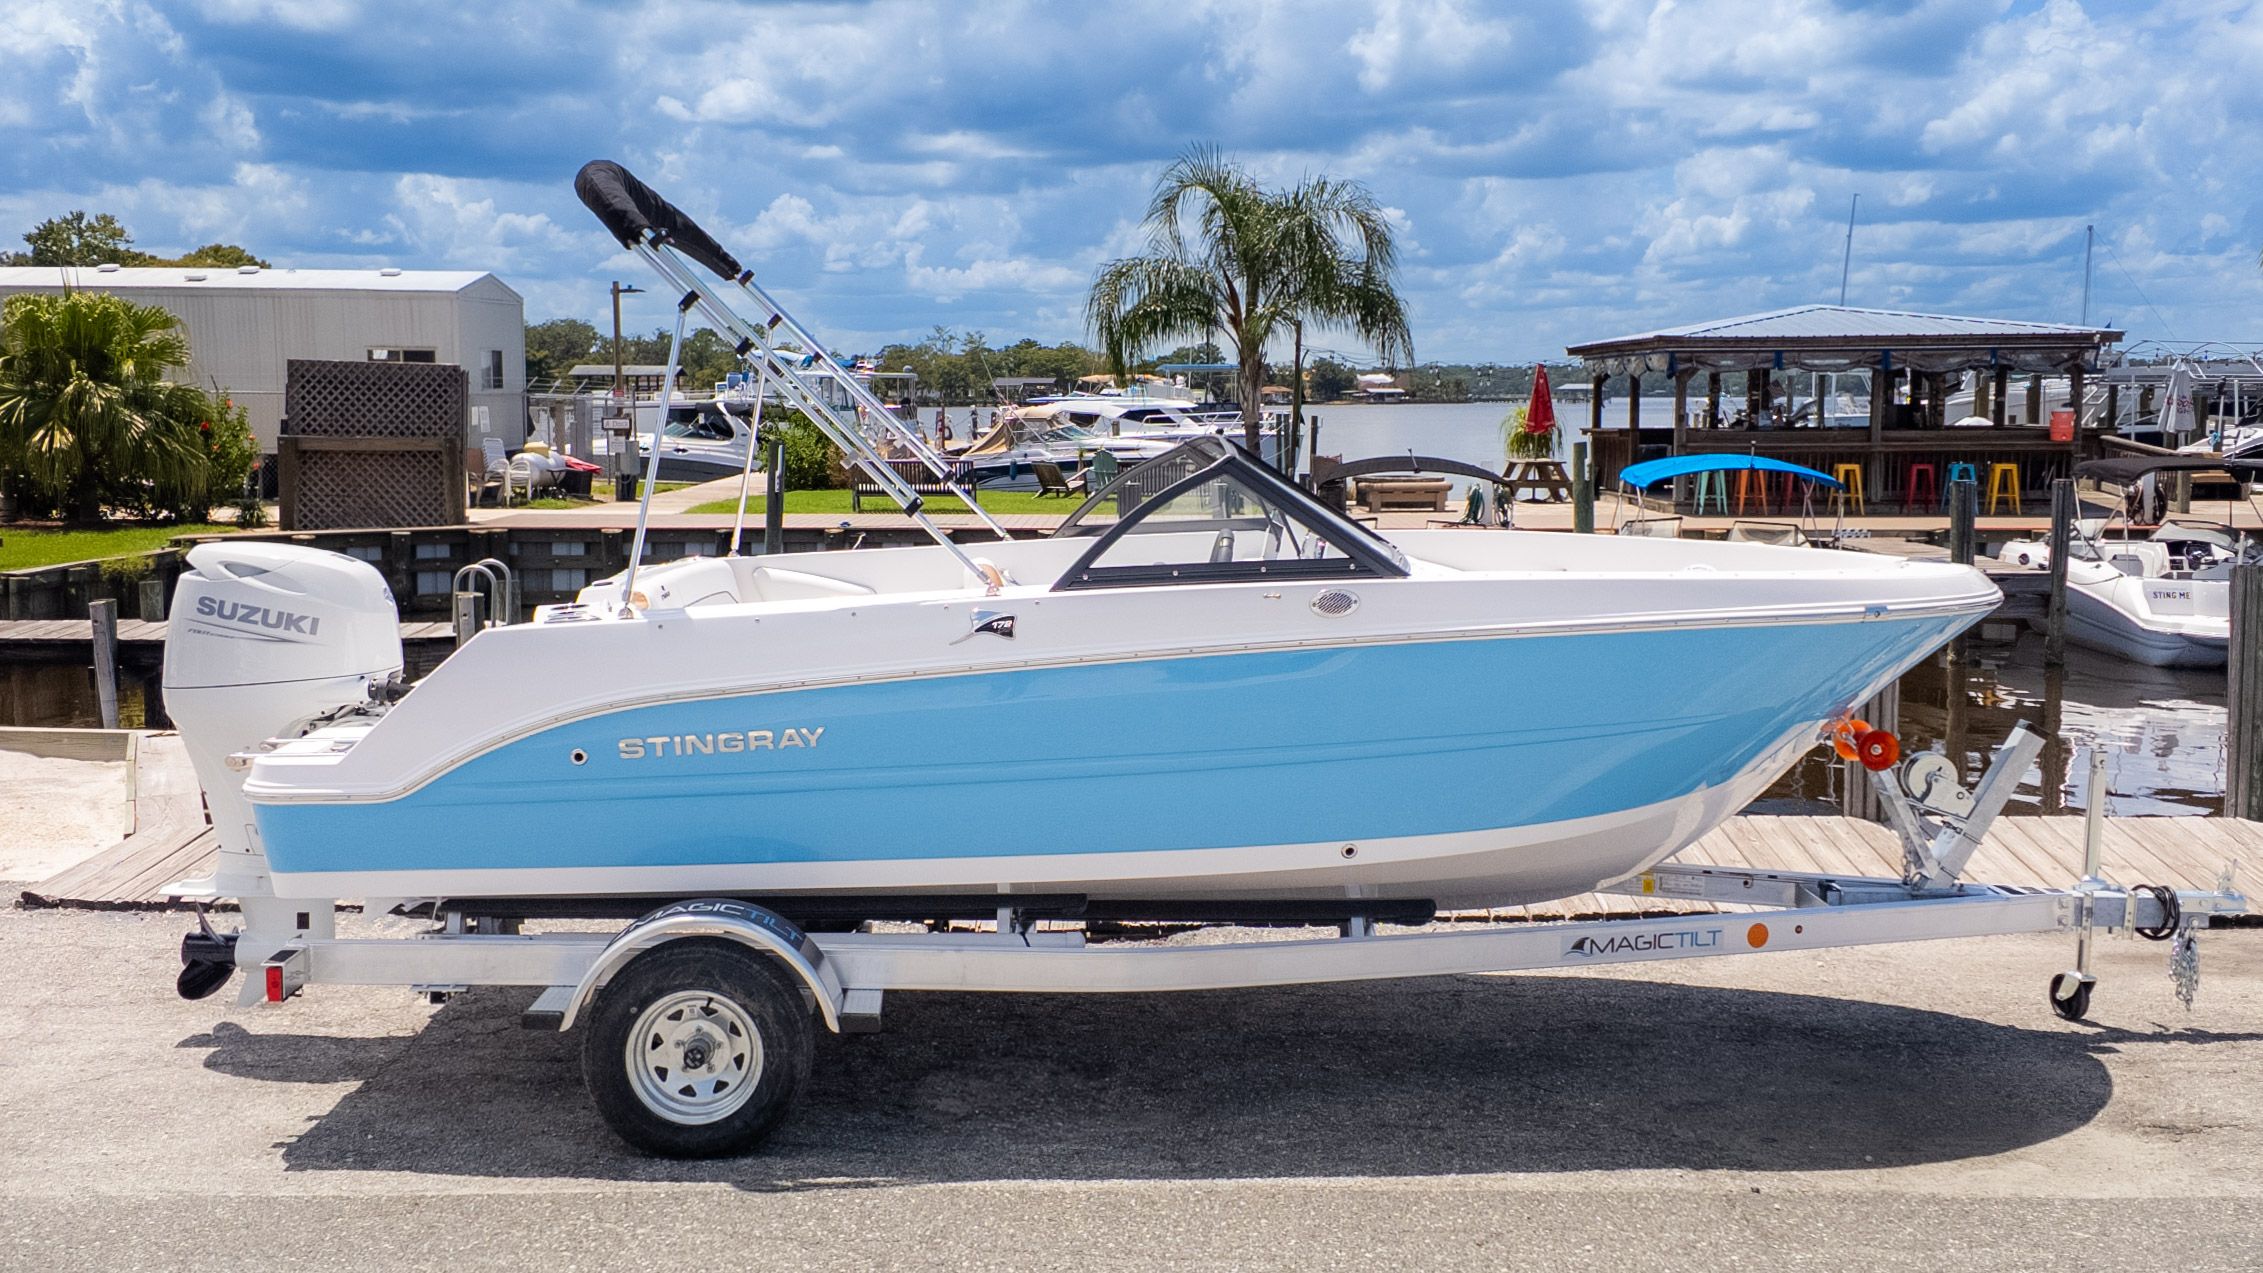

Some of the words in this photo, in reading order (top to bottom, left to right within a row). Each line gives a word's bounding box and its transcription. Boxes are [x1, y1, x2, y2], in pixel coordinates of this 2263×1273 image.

[2152, 591, 2177, 600] STING
[2178, 591, 2191, 600] ME
[196, 596, 320, 636] SUZUKI
[618, 726, 825, 759] STINGRAY
[1589, 929, 1723, 955] MAGICTILT
